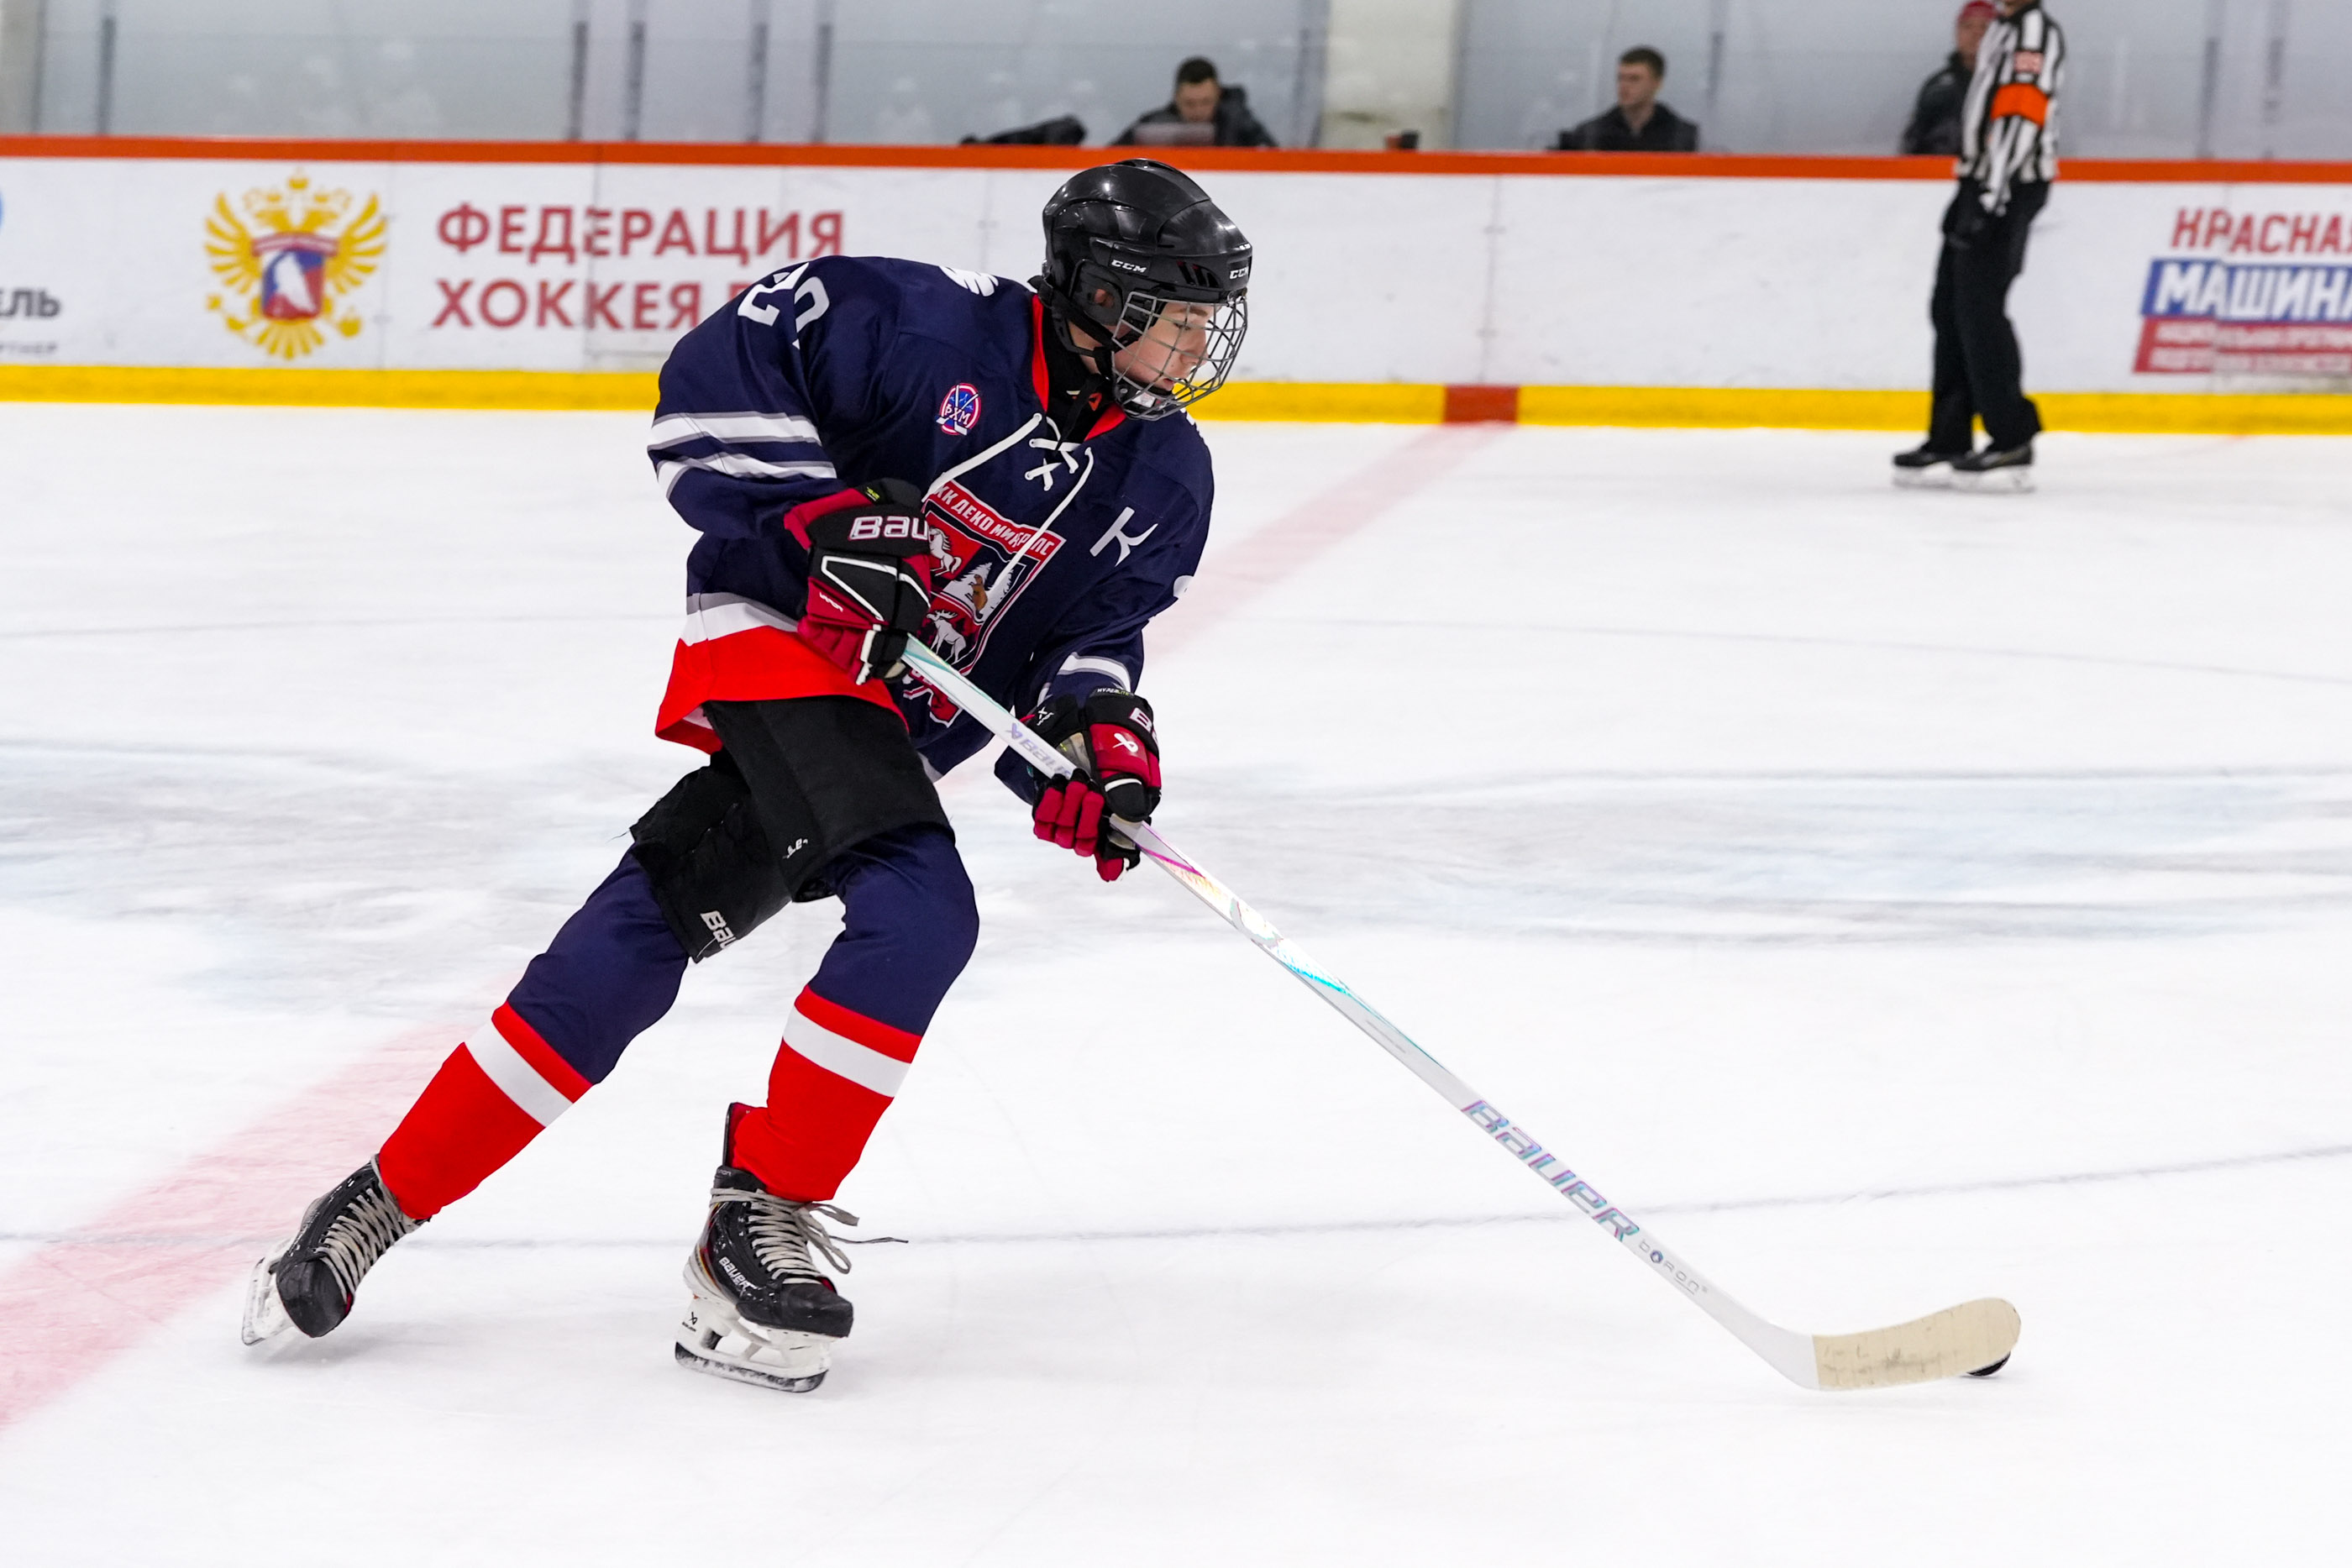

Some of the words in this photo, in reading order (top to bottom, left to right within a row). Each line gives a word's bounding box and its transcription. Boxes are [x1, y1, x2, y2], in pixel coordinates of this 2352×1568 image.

[437, 202, 843, 265] ФЕДЕРАЦИЯ
[2170, 207, 2352, 254] КРАСНА
[1110, 259, 1147, 273] CCM
[432, 278, 702, 330] ХОККЕЯ
[950, 499, 995, 532] ДЕКО
